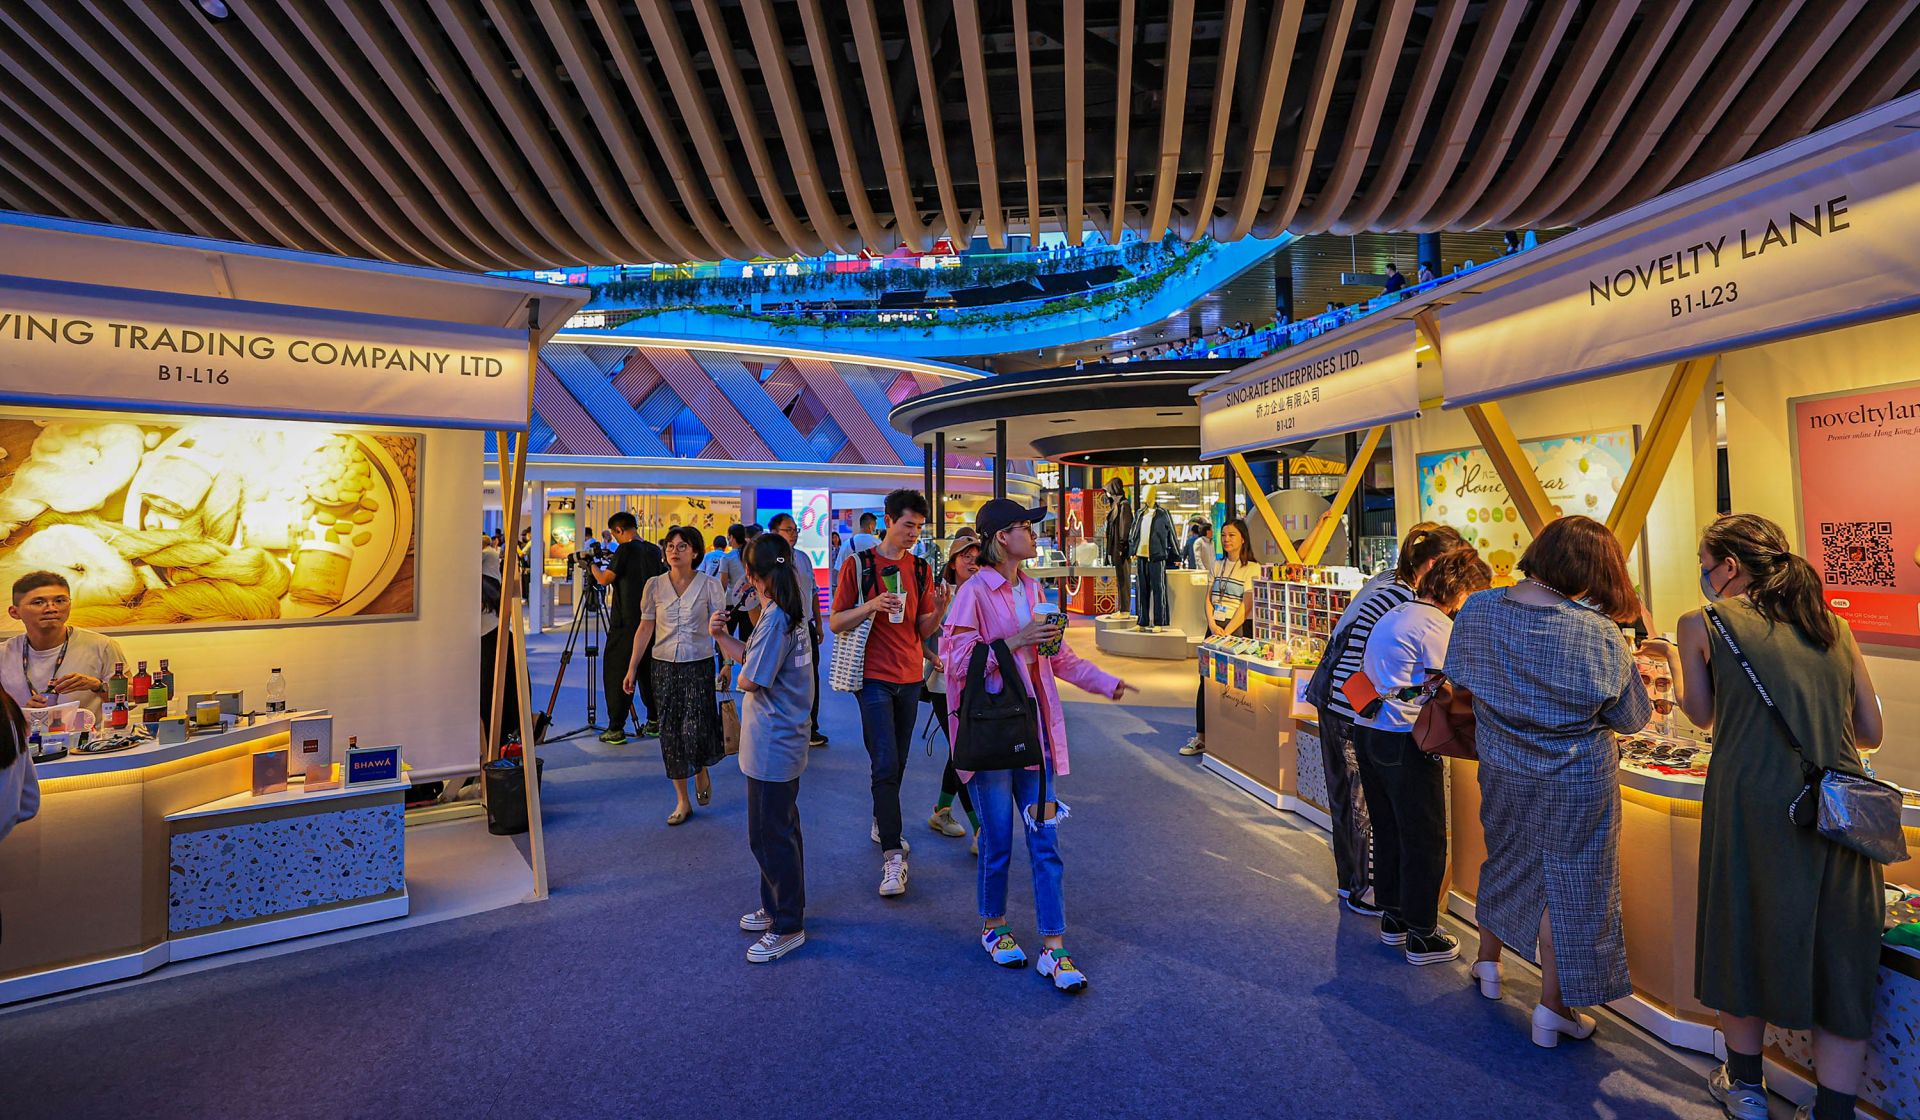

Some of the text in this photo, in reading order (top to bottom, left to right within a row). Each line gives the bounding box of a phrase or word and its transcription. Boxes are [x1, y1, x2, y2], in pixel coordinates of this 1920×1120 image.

[1589, 195, 1850, 306] NOVELTY LANE
[1671, 281, 1739, 317] B1-L23
[108, 323, 275, 360] TRADING
[288, 340, 450, 374] COMPANY
[460, 355, 503, 378] LTD
[158, 364, 230, 385] B1-L16
[1226, 349, 1363, 408] SINO-RATE ENTERPRISES LTD.
[1276, 416, 1295, 432] B1-L21
[1827, 433, 1851, 442] Premier
[1873, 429, 1893, 438] Hong
[1894, 427, 1912, 436] Kong
[1139, 464, 1212, 485] POP MART
